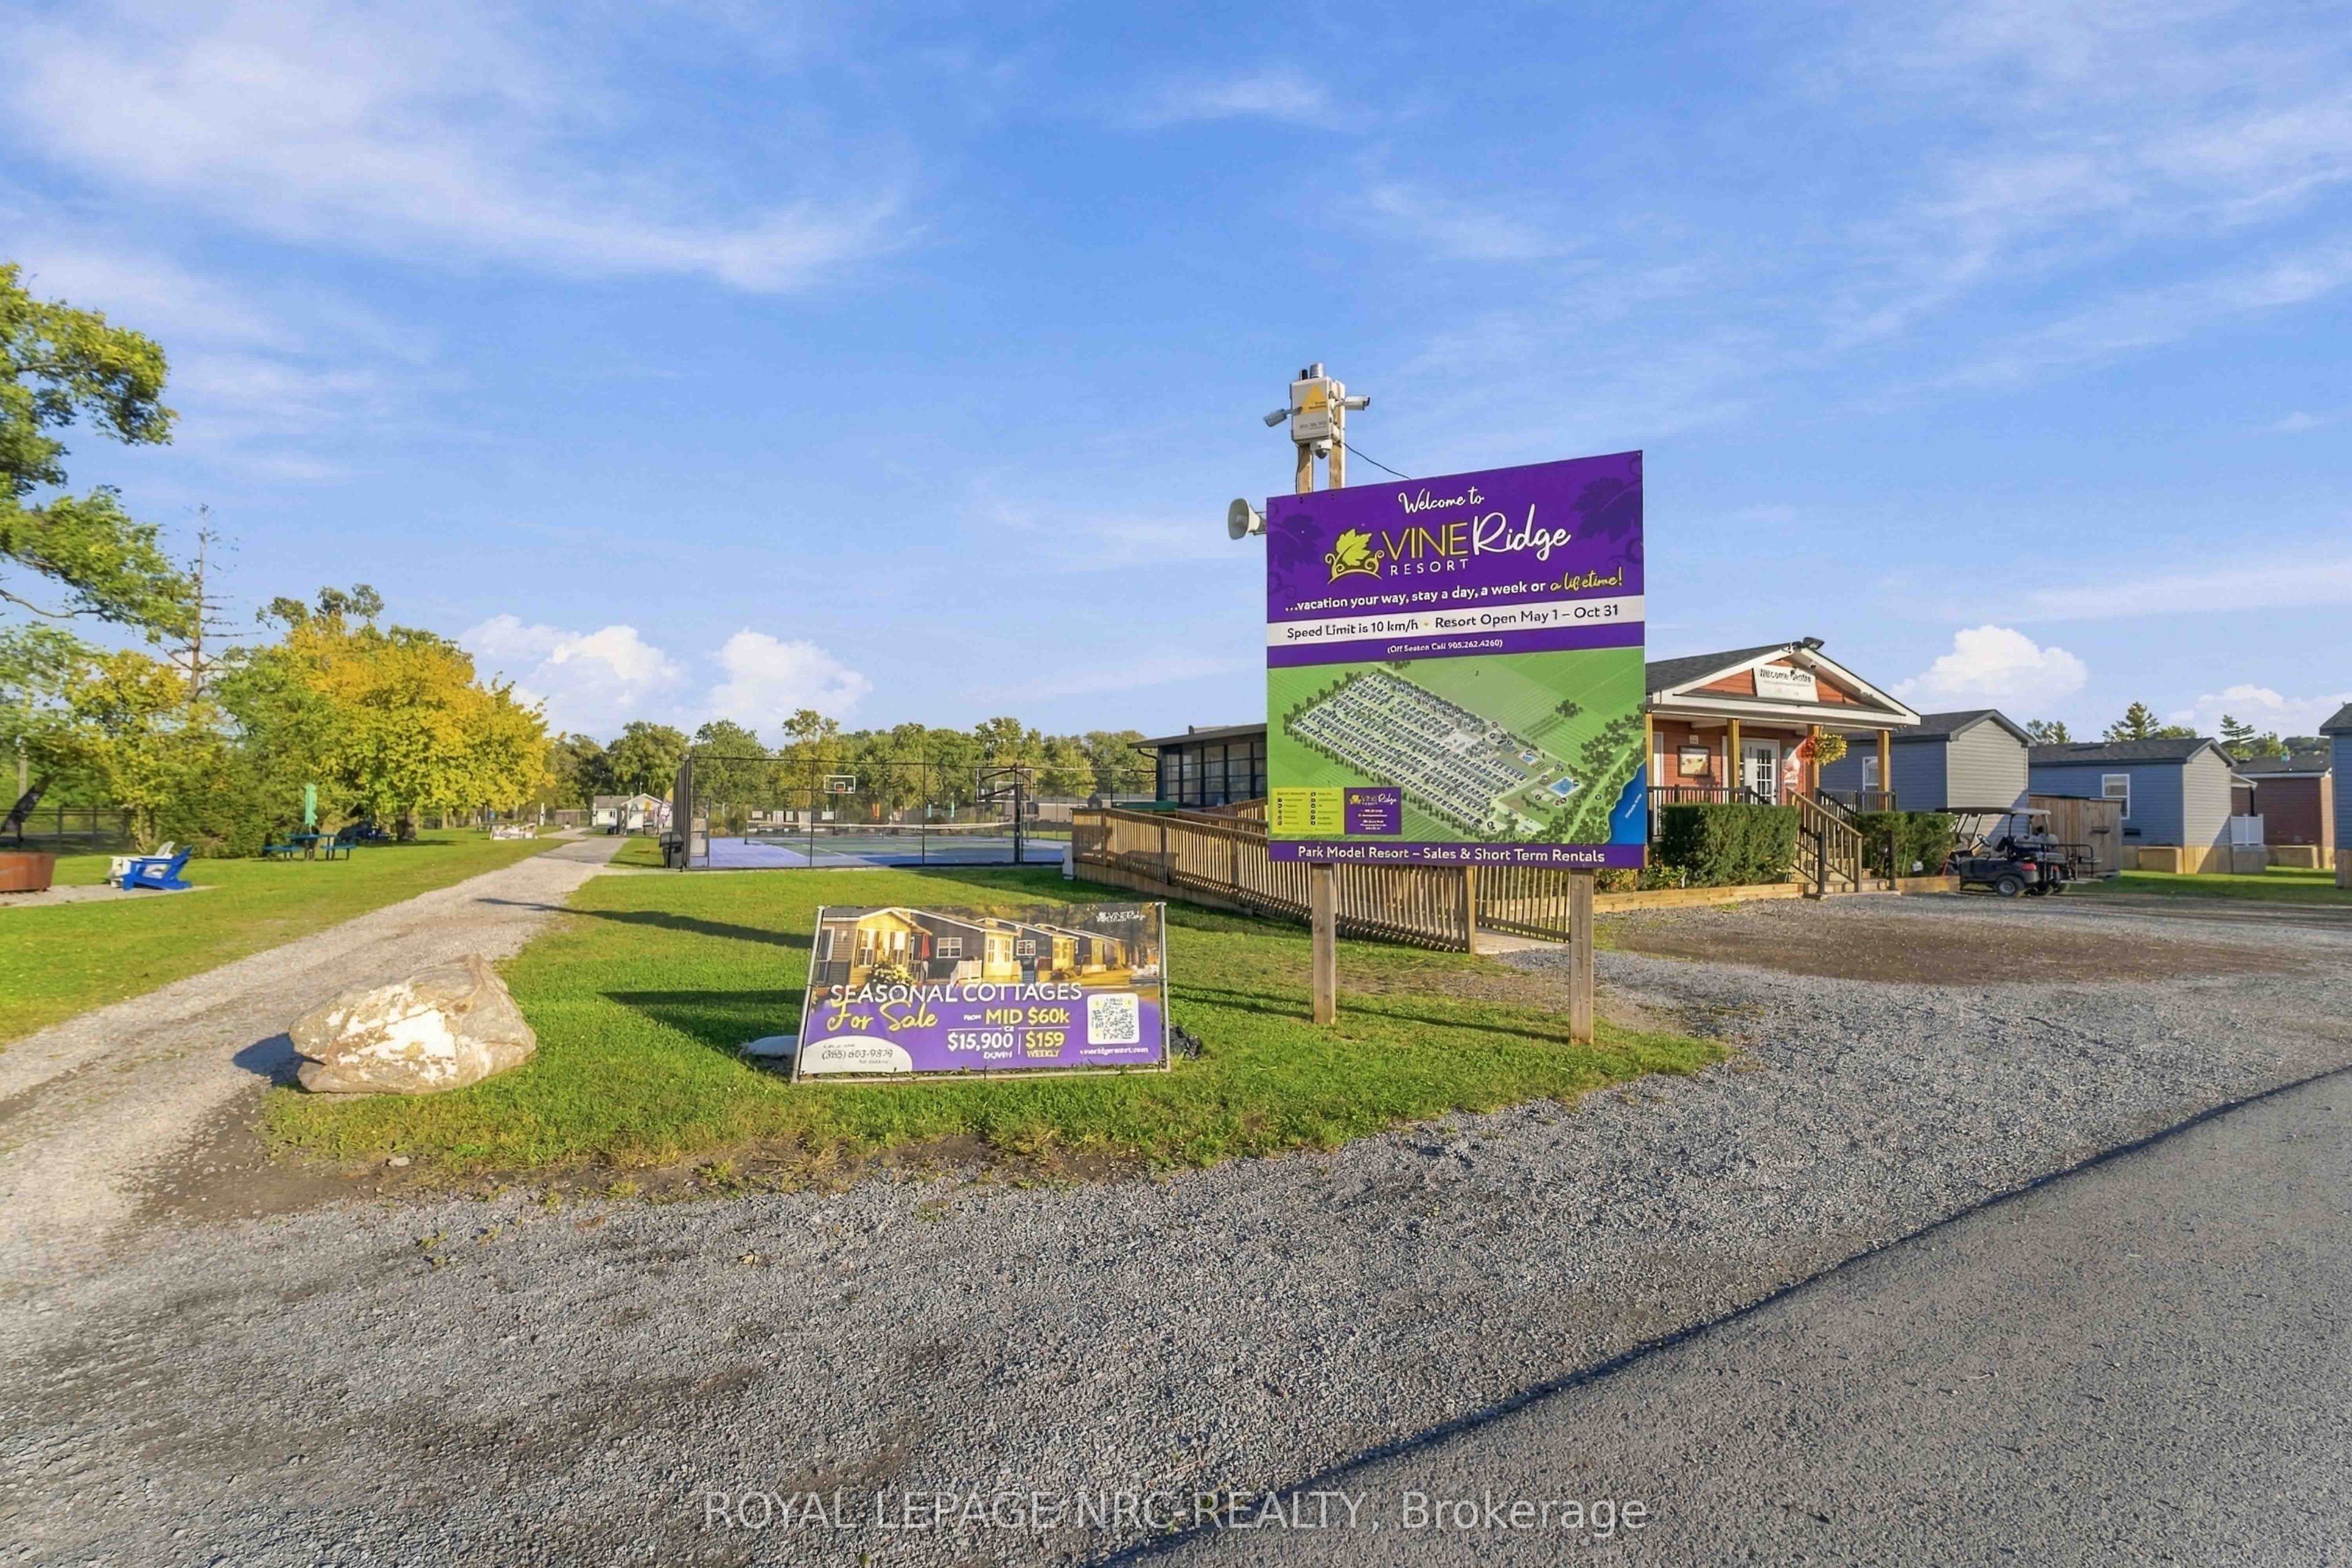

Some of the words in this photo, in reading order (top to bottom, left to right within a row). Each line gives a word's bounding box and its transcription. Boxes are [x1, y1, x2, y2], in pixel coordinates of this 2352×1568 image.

[1398, 488, 1465, 513] Welcome
[1468, 486, 1484, 504] to
[1382, 522, 1468, 560] VINE
[1472, 503, 1571, 561] Ridge
[1390, 559, 1468, 576] RESORT
[1286, 597, 1348, 611] ...vacation
[1351, 597, 1379, 608] your
[1381, 594, 1409, 605] way,
[1412, 590, 1438, 602] stay
[1452, 585, 1479, 600] day,
[1480, 587, 1488, 595] a
[1491, 581, 1528, 595] week
[1531, 582, 1545, 592] or
[1550, 582, 1561, 592] a
[1564, 567, 1623, 591] lifetime!
[1436, 617, 1476, 628] Resort
[1480, 614, 1517, 627] Open
[1521, 611, 1548, 624] May
[1552, 609, 1558, 620] 1
[1574, 607, 1600, 618] Oct
[1604, 605, 1618, 616] 31
[1287, 626, 1322, 640] Speed
[1326, 624, 1355, 636] Limit
[1359, 623, 1368, 633] is
[1371, 622, 1384, 632] 10
[1387, 619, 1418, 633] km/h
[1387, 645, 1403, 654] (Off
[1298, 846, 1324, 858] Park
[1327, 846, 1365, 858] Model
[1369, 847, 1409, 858] Resort
[1423, 848, 1457, 859] Sales
[1460, 848, 1470, 860] &
[1474, 848, 1511, 861] Short
[1513, 848, 1548, 861] Term
[1552, 849, 1605, 862] Rentals
[830, 983, 958, 1003] SEASONAL
[962, 982, 1082, 1002] COTTAGES
[827, 998, 873, 1032] For
[880, 999, 938, 1032] Sale
[986, 1009, 1023, 1025] MID
[1028, 1006, 1070, 1025] $60k
[948, 1032, 1014, 1051] $15,900
[1025, 1030, 1065, 1049] $159
